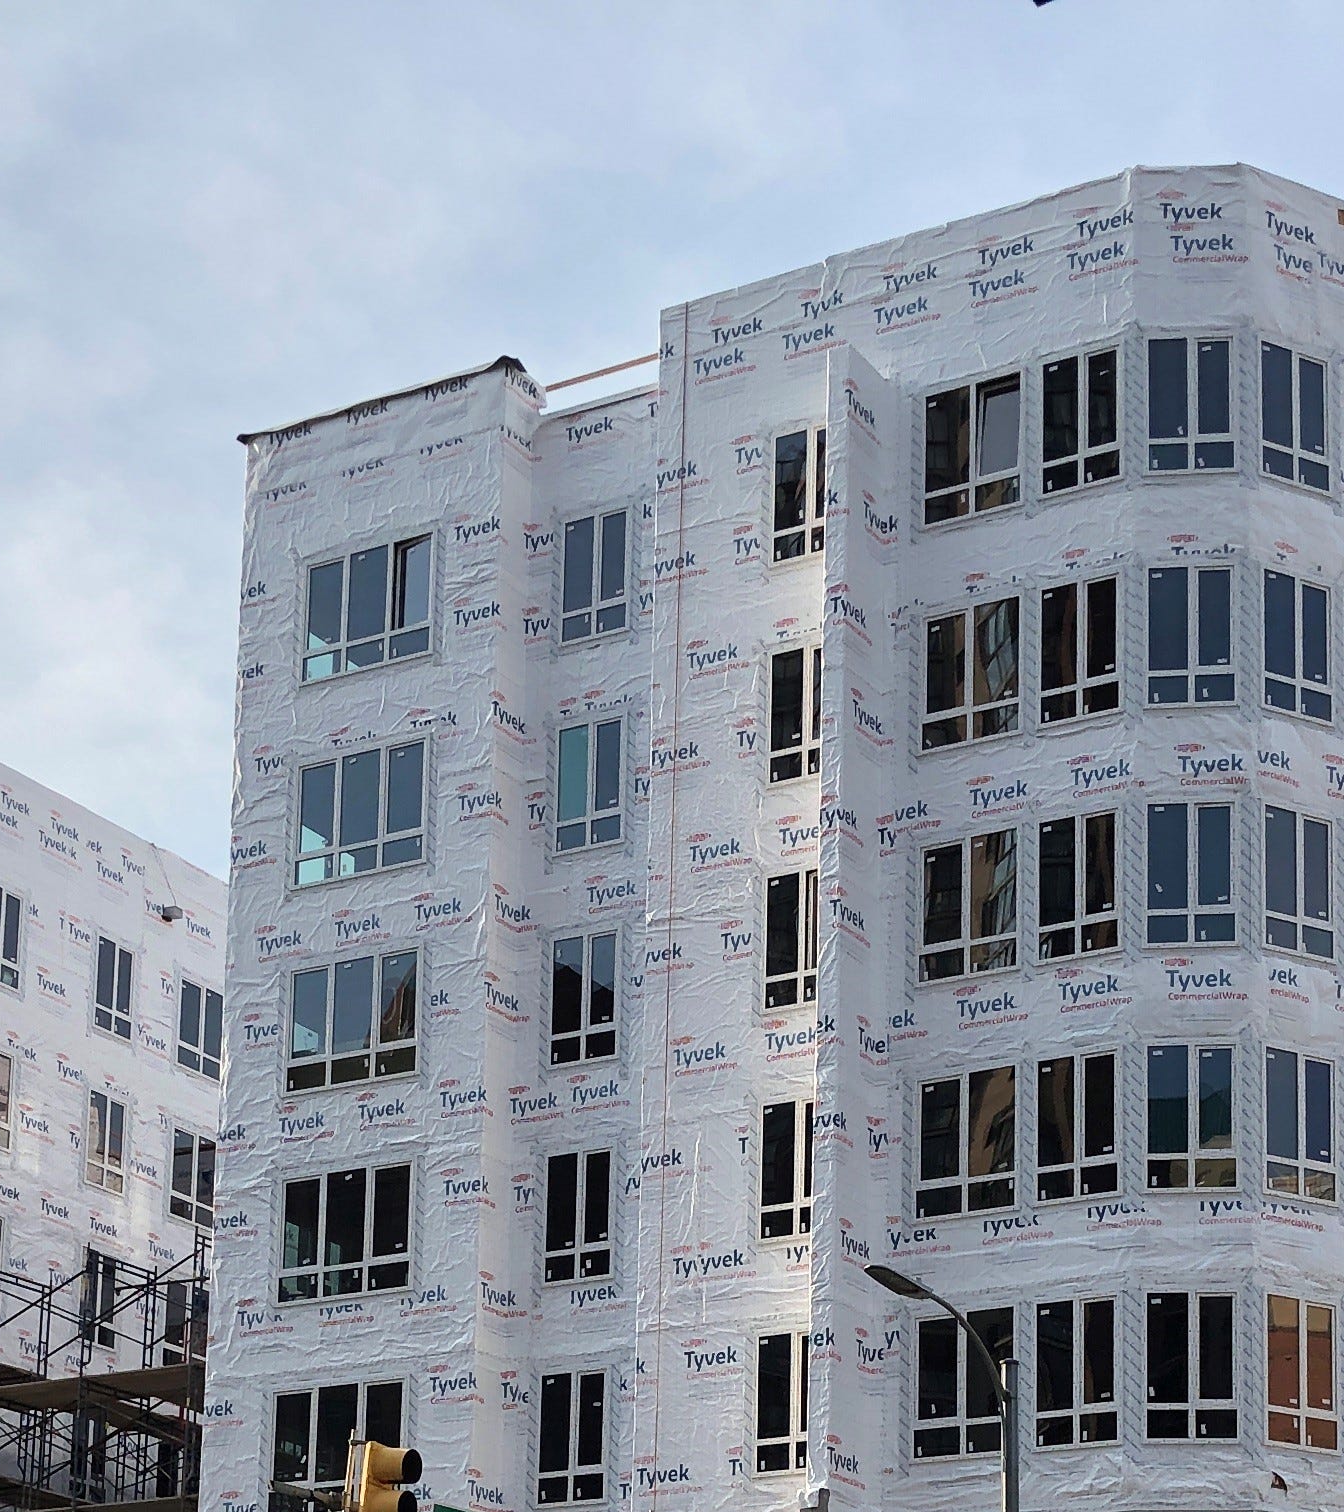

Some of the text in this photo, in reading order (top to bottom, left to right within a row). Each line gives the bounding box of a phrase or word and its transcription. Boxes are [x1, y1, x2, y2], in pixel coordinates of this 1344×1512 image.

[1077, 209, 1133, 241] Tyvek
[1160, 203, 1222, 223] Tyvek
[1265, 211, 1316, 245] Tyvek
[978, 235, 1033, 267] Tyvek
[1066, 240, 1124, 274] Tyvek
[1170, 234, 1233, 256] Tyvek
[883, 261, 937, 293] Tyvek
[965, 268, 1024, 299] Tyvek
[871, 295, 928, 326] Tyvek
[712, 317, 762, 346] Tyvek
[782, 323, 836, 354] Tyvek
[693, 348, 743, 376] Tyvek
[566, 417, 612, 443] Tyvek
[455, 516, 500, 543] Tyvek
[454, 601, 500, 627] Tyvek
[830, 596, 866, 630] Tyvek
[687, 640, 737, 671] Tyvek
[492, 701, 527, 734] Tyvek
[1071, 756, 1129, 790] Tyvek
[1178, 754, 1243, 778] Tyvek
[1, 791, 29, 815] Tyvek
[458, 791, 502, 813] Tyvek
[970, 780, 1027, 809] Tyvek
[689, 838, 739, 864] Tyvek
[587, 880, 637, 906] Tyvek
[414, 897, 461, 921] Tyvek
[495, 894, 530, 922] Tyvek
[830, 899, 864, 933] Tyvek
[186, 916, 210, 939] Tyvek
[335, 910, 380, 939] Tyvek
[257, 926, 301, 956] Tyvek
[1058, 975, 1121, 1006] Tyvek
[1166, 969, 1231, 992] Tyvek
[484, 982, 518, 1011] Tyvek
[957, 991, 1017, 1023] Tyvek
[440, 1086, 487, 1115] Tyvek
[510, 1090, 557, 1117] Tyvek
[570, 1078, 618, 1107] Tyvek
[20, 1111, 48, 1133] Tyvek
[279, 1111, 325, 1136] Tyvek
[358, 1099, 404, 1123] Tyvek
[41, 1198, 69, 1218] Tyvek
[90, 1217, 117, 1237] Tyvek
[841, 1230, 869, 1260] Tyvek
[481, 1282, 516, 1306] Tyvek
[684, 1346, 736, 1372] Tyvek
[430, 1371, 477, 1396] Tyvek
[827, 1447, 858, 1474] Tyvek
[637, 1464, 689, 1486] Tyvek
[468, 1480, 505, 1504] Tyvek
